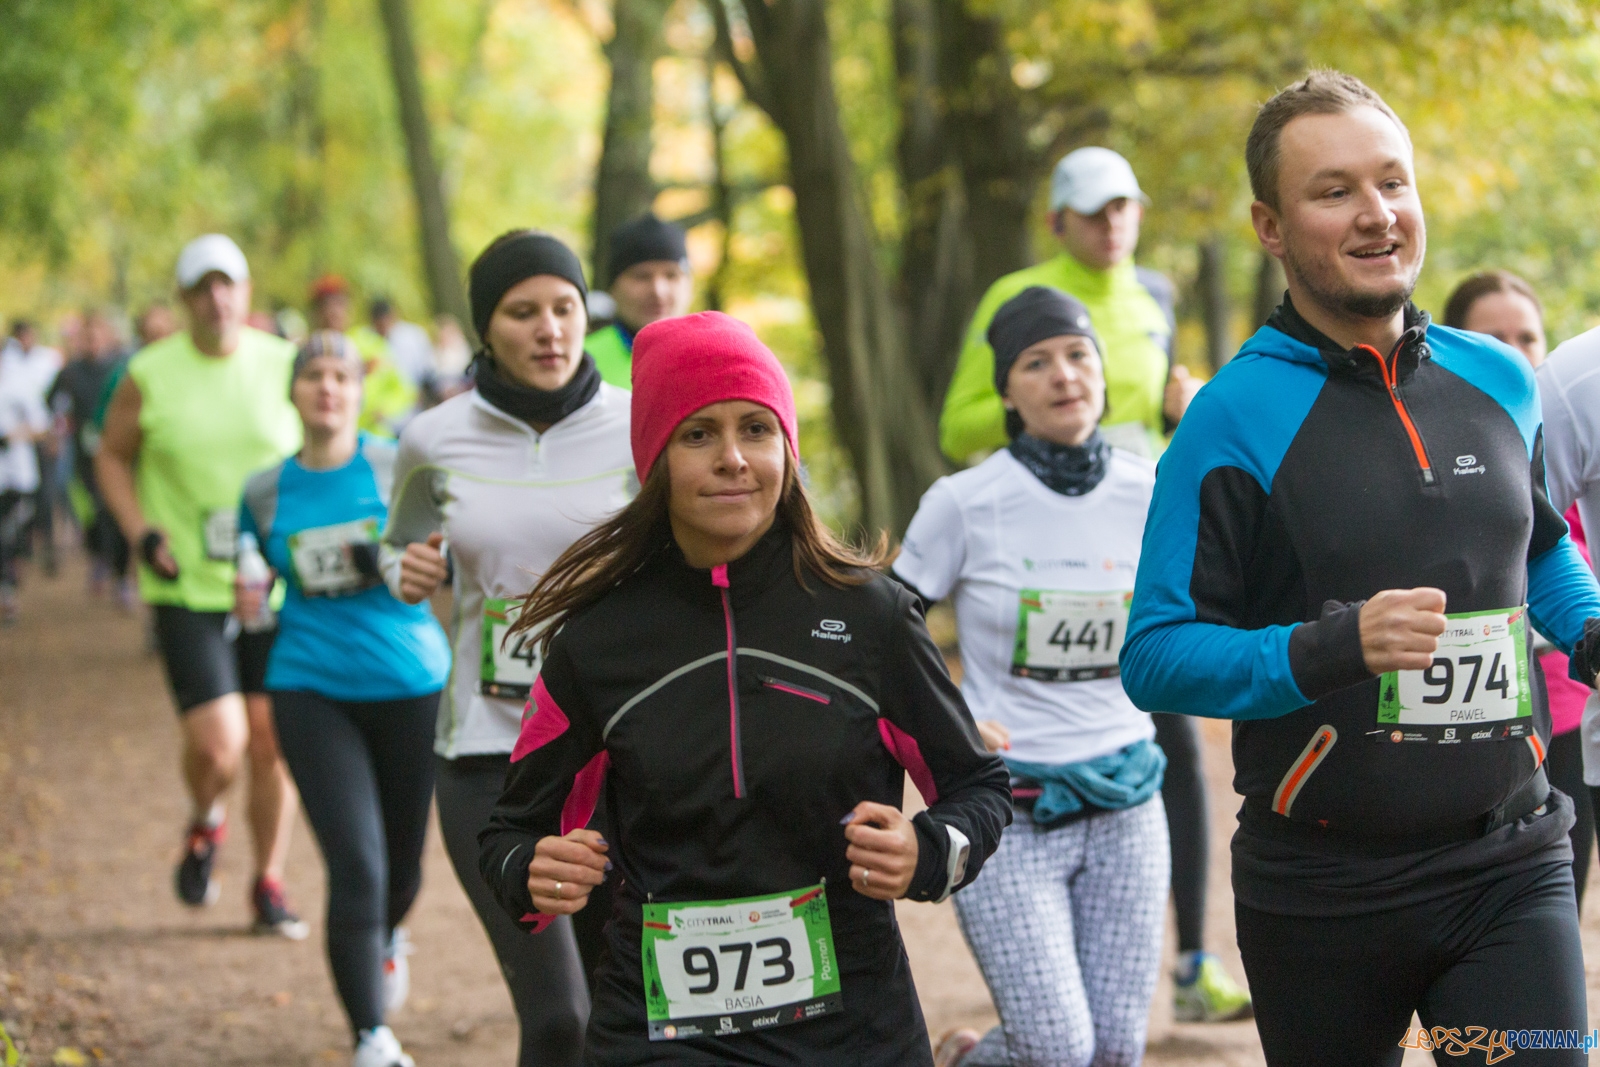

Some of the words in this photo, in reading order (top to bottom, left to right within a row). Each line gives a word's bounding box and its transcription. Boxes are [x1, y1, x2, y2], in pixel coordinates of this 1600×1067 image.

[811, 629, 852, 643] Kalenji
[1048, 620, 1114, 652] 441
[1422, 652, 1509, 704] 974
[1450, 709, 1486, 721] PAWEŁ
[683, 937, 795, 995] 973
[817, 937, 832, 981] Poznań
[725, 995, 764, 1011] BASIA
